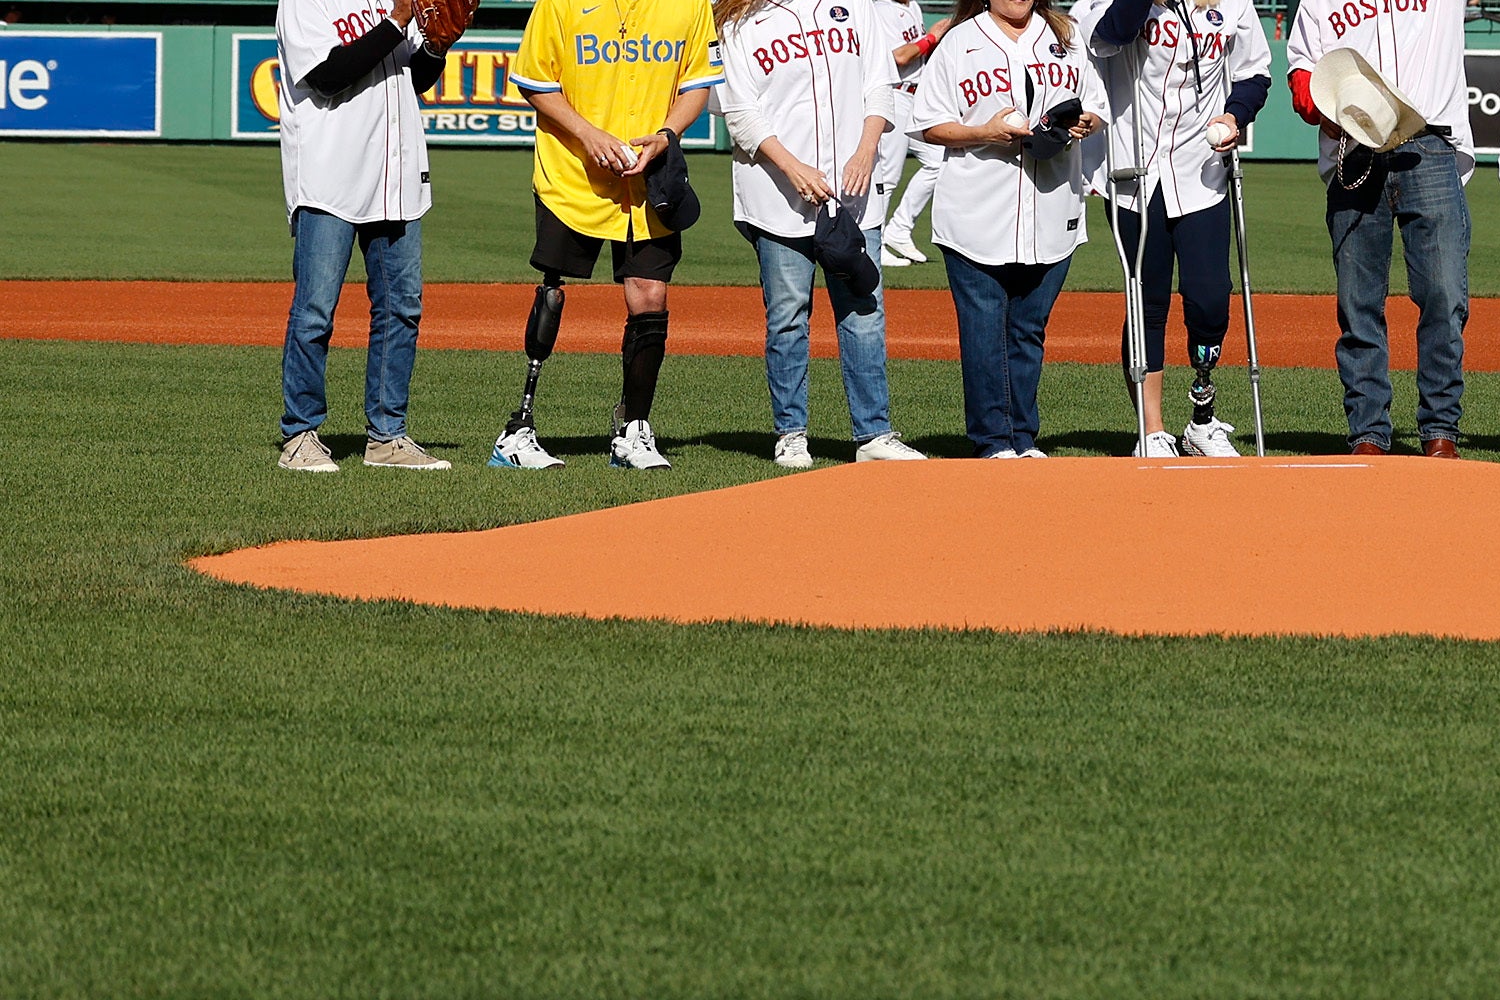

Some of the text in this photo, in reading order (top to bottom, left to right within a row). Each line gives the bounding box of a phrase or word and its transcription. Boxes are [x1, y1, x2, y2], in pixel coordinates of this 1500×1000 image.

[576, 33, 685, 65] Boston
[753, 27, 861, 76] BOSTON
[959, 62, 1080, 107] BOSTON
